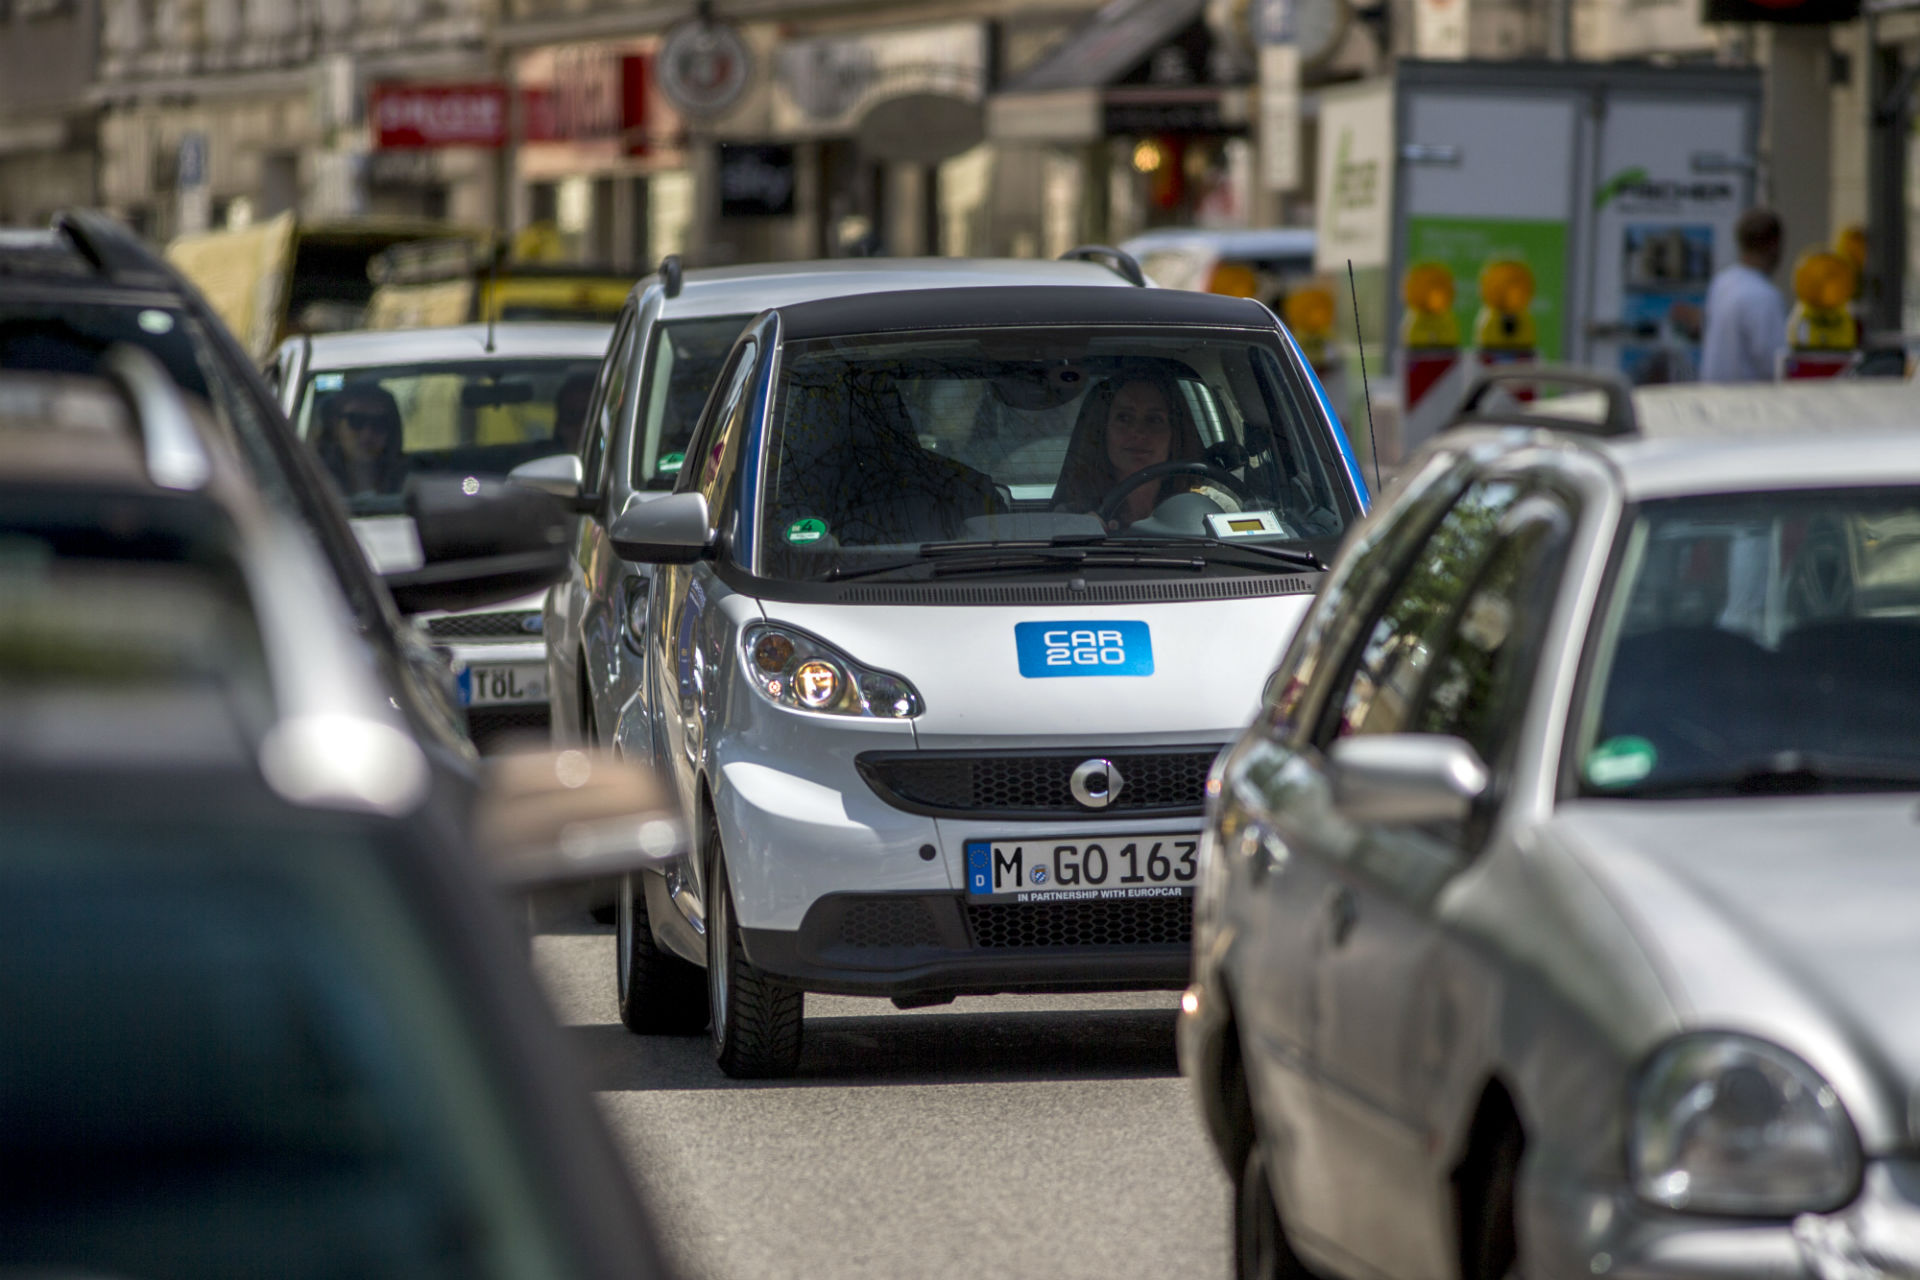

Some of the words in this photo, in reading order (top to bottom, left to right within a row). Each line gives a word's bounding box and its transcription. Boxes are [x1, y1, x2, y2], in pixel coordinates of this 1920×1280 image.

[801, 520, 812, 531] 4
[1044, 630, 1124, 647] CAR
[1046, 647, 1126, 666] 2GO
[475, 669, 524, 698] TÖL
[994, 847, 1023, 888] M
[1053, 844, 1109, 886] GO
[1120, 841, 1197, 884] 163
[975, 874, 985, 887] D
[1018, 893, 1029, 902] IN
[1031, 890, 1099, 902] PARTNERSHIP
[1100, 889, 1126, 899] WITH
[1128, 887, 1182, 898] EUROPCAR
